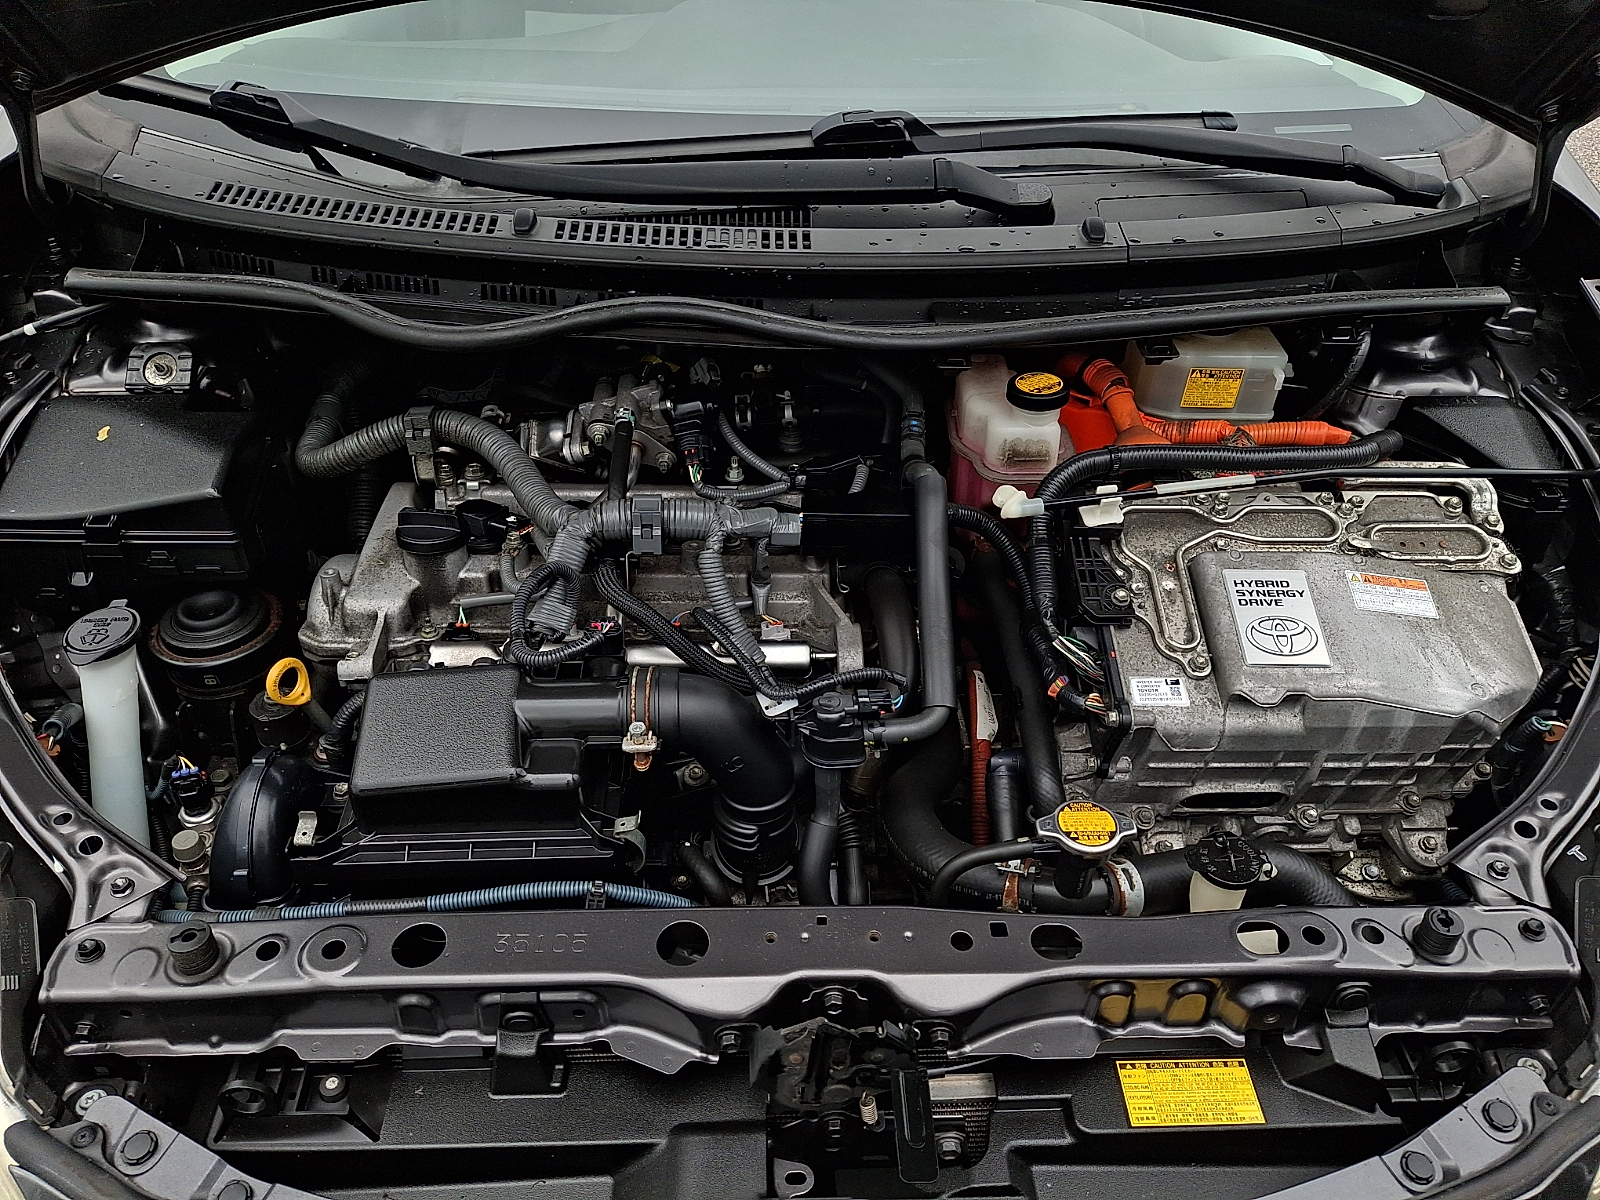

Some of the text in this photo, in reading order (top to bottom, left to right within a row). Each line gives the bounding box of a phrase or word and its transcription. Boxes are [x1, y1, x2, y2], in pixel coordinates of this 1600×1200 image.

[1233, 579, 1290, 588] HYBRID
[1235, 589, 1305, 598] SYNERGY
[1237, 598, 1285, 607] DRIVE
[493, 933, 589, 953] 35105
